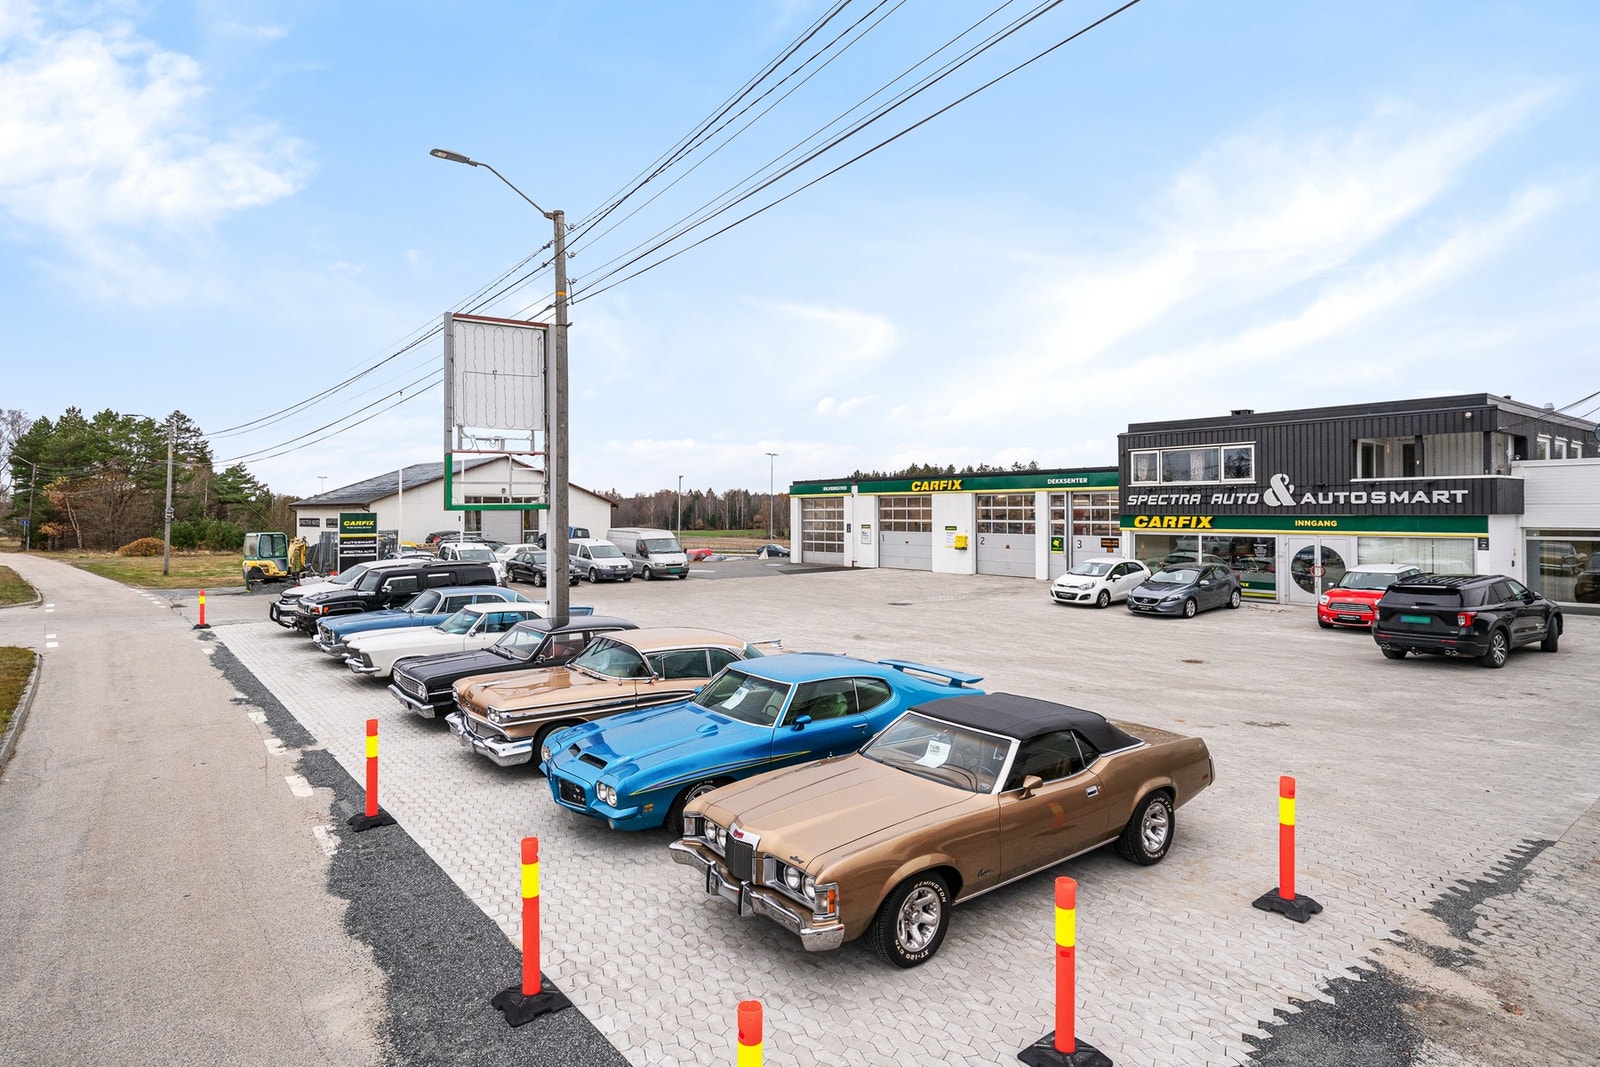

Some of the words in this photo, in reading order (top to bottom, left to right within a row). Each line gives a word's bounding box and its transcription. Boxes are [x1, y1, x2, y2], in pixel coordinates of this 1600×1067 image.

[911, 480, 962, 492] CARFIX
[1127, 493, 1201, 506] SPECTRA
[1210, 492, 1260, 505] AUTO
[1263, 473, 1297, 507] &
[1300, 490, 1469, 505] AUTOSMART
[1133, 515, 1213, 529] CARFIX
[1294, 519, 1338, 527] INNGANG
[881, 534, 885, 542] 1
[980, 536, 985, 545] 2
[1077, 539, 1083, 549] 3
[913, 881, 947, 903] REMINGTON
